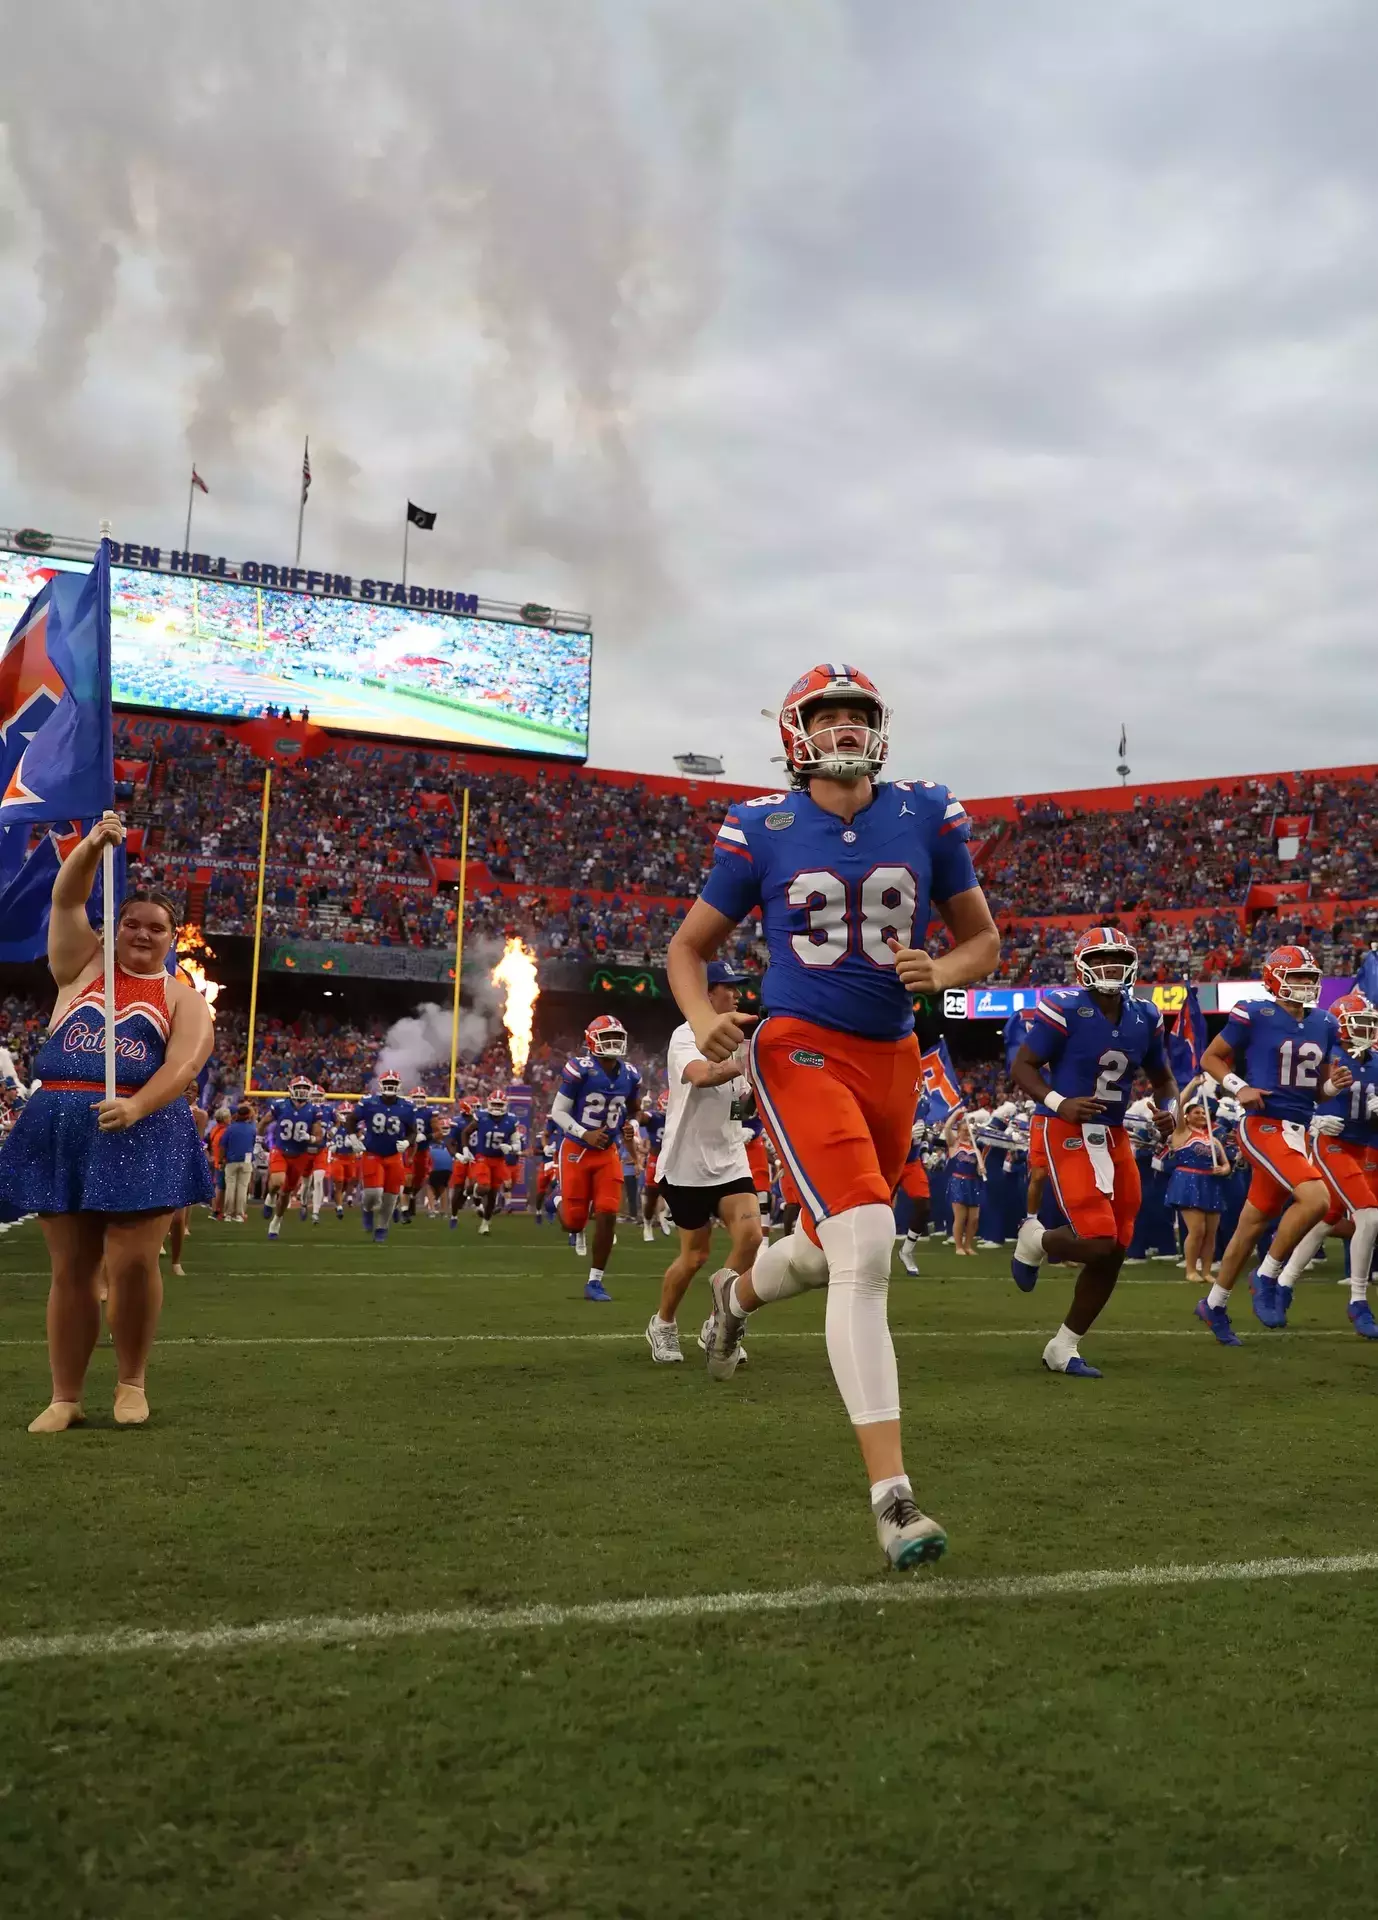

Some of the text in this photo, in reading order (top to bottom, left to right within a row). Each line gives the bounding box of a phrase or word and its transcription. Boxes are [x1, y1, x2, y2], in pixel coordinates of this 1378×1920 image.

[171, 550, 231, 578] HILL
[242, 561, 352, 596] GRIFFIN
[360, 579, 479, 614] STADIUM
[787, 863, 916, 968] 38
[946, 995, 966, 1013] 25
[63, 1022, 146, 1060] Gatrs
[1278, 1039, 1324, 1088] 12
[1096, 1049, 1129, 1101] 2
[372, 1112, 401, 1136] 93
